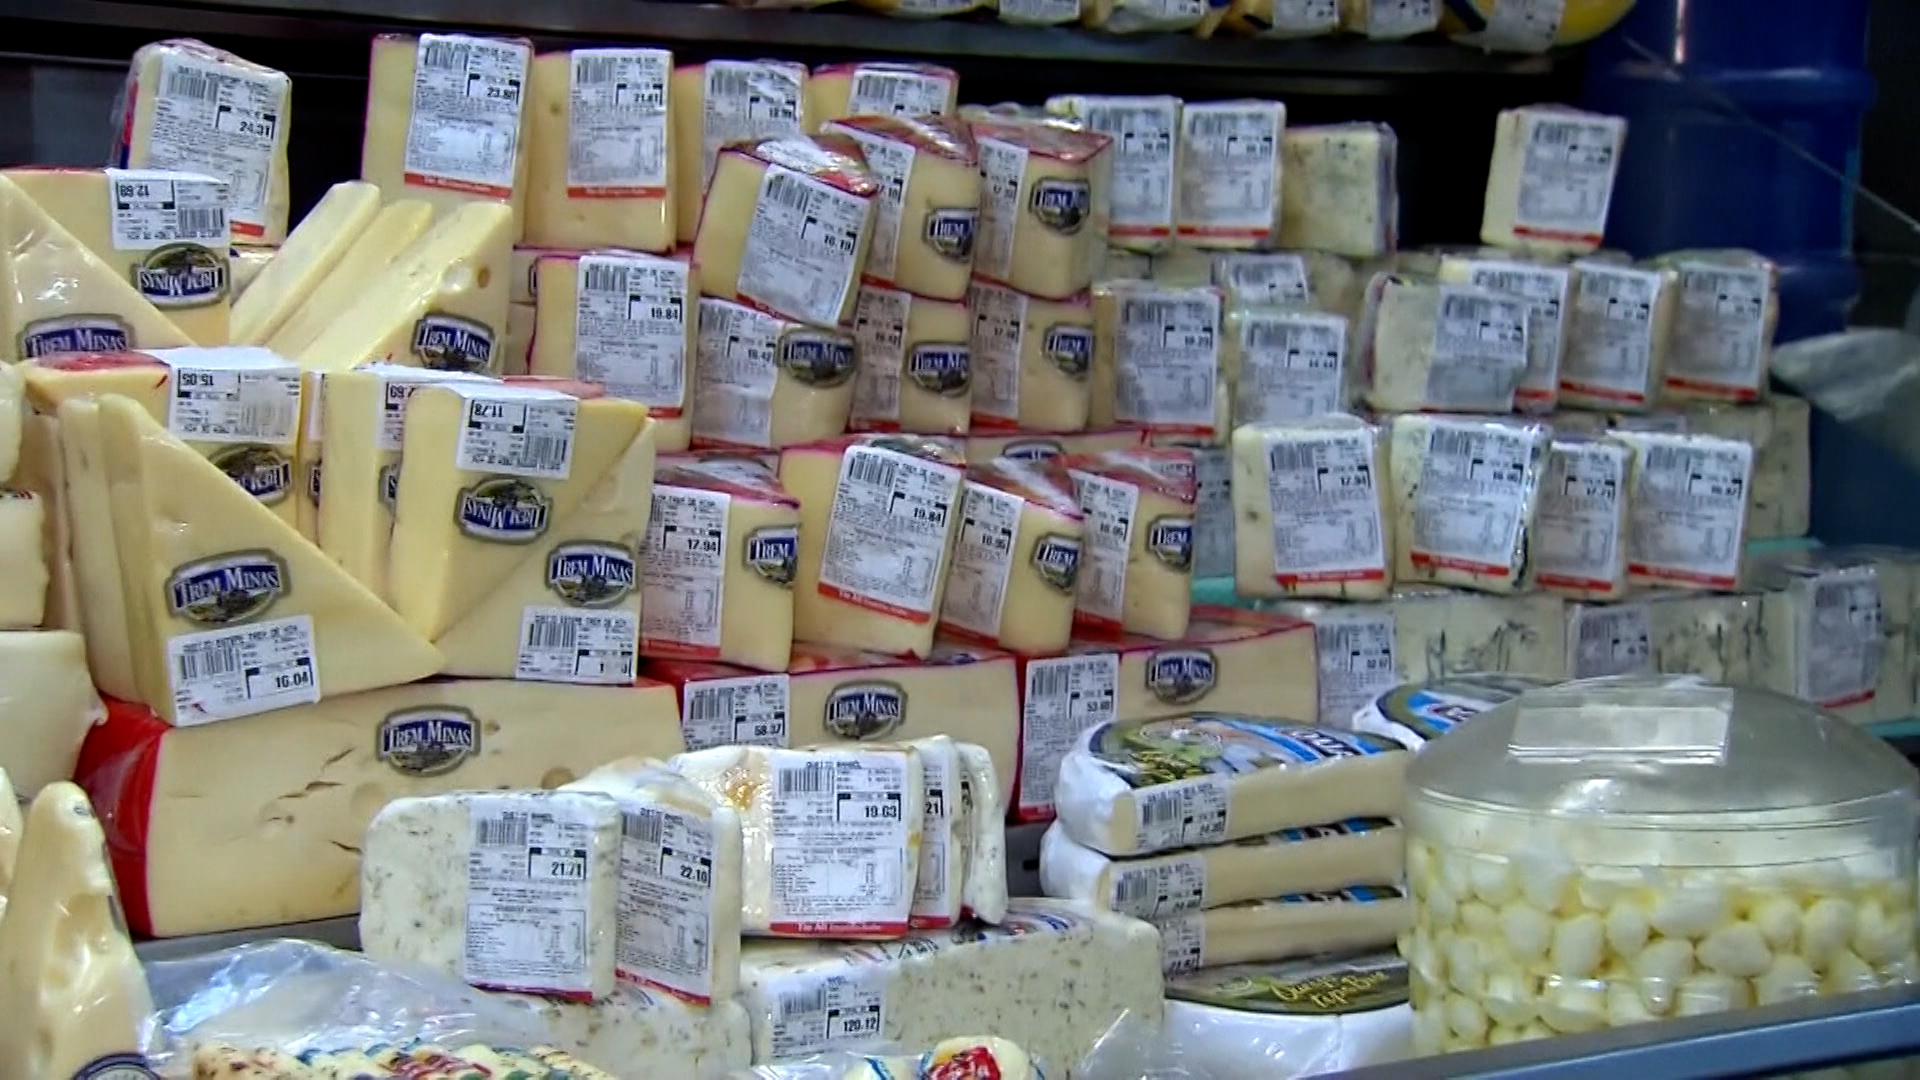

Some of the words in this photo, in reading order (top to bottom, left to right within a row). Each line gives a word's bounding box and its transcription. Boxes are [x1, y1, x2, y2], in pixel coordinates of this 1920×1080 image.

[182, 373, 214, 386] 15.05
[463, 497, 504, 529] MINAS
[509, 503, 543, 530] TREM
[1157, 528, 1189, 546] TREM
[755, 540, 791, 559] TREM
[556, 558, 588, 580] TREM
[591, 556, 633, 583] MINAS
[177, 575, 222, 603] TREM
[224, 567, 280, 593] MINAS
[387, 726, 425, 750] TREM
[427, 721, 472, 746] MINAS
[550, 861, 583, 877] 21.71
[679, 864, 709, 883] 22.10
[842, 1016, 879, 1033] 120.12
